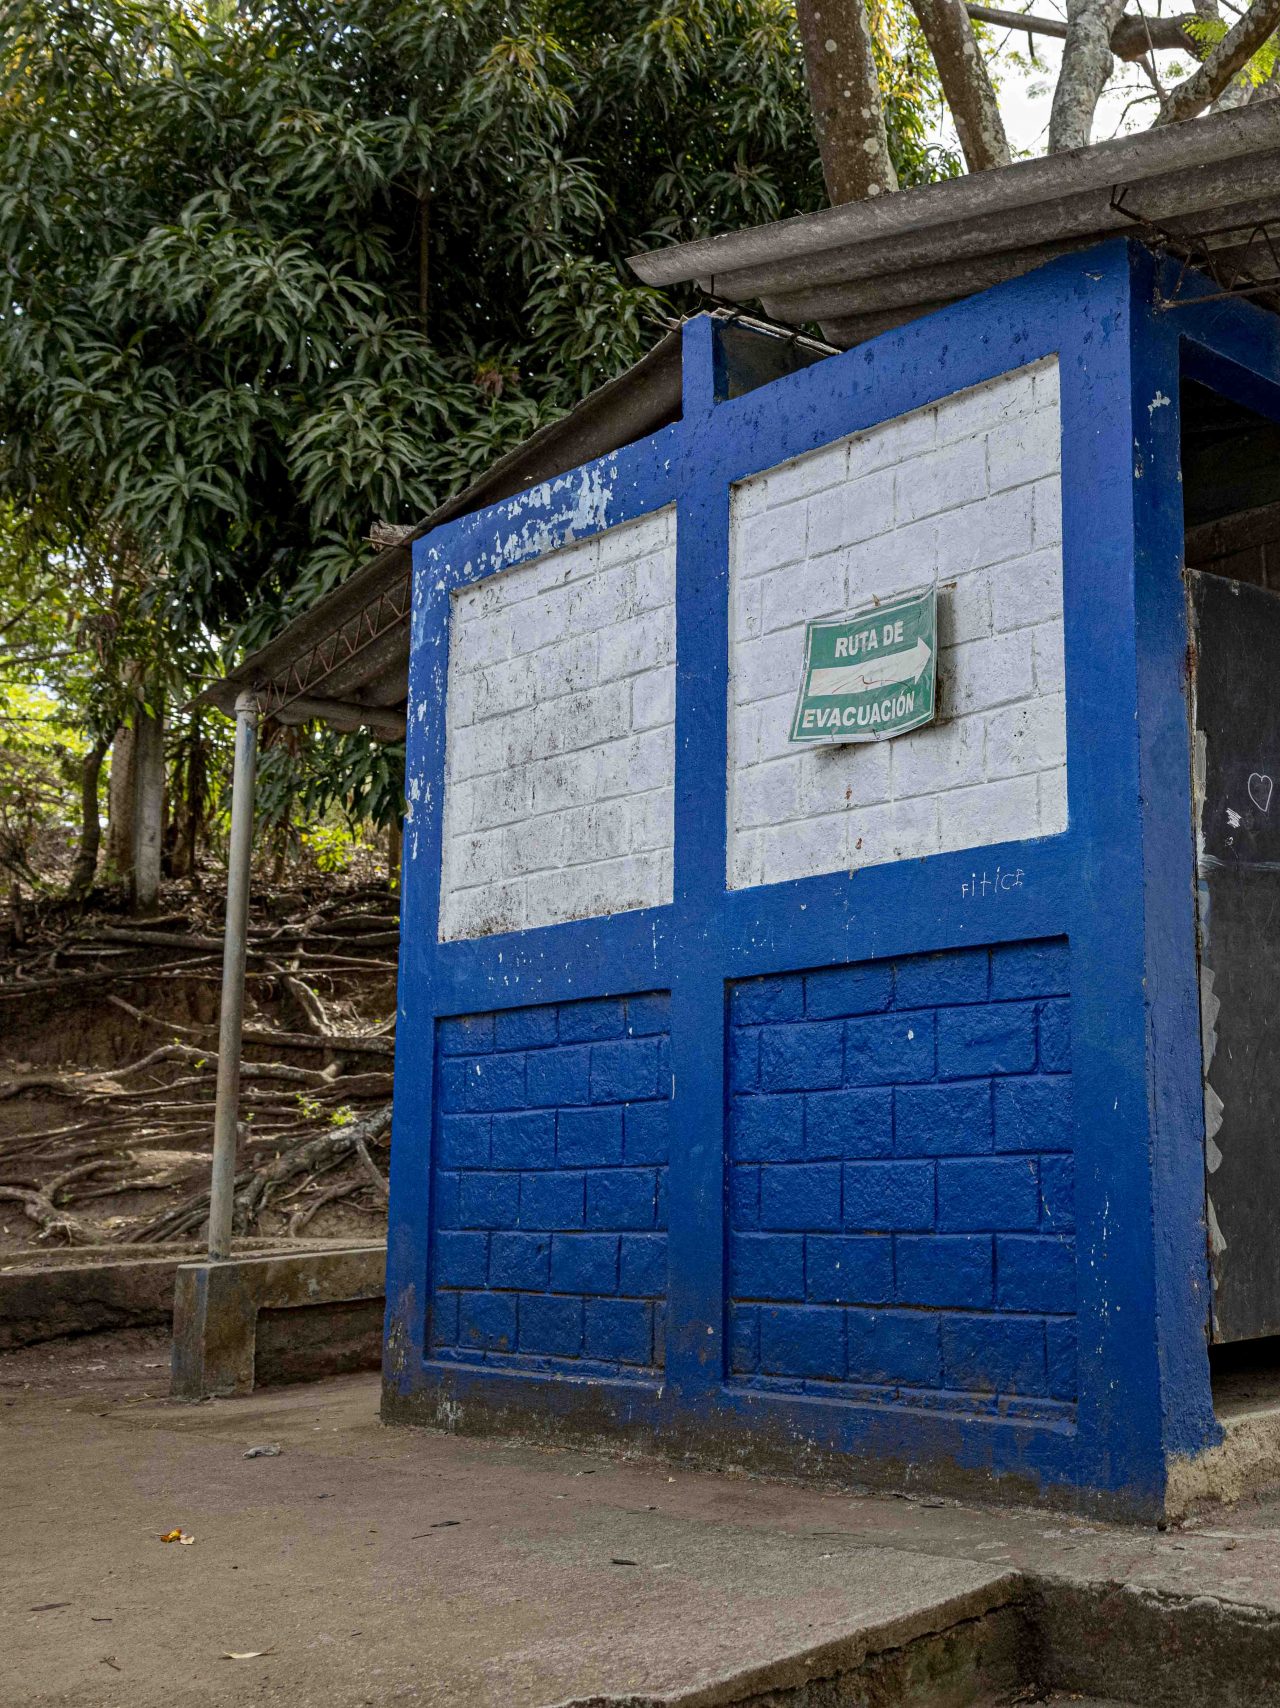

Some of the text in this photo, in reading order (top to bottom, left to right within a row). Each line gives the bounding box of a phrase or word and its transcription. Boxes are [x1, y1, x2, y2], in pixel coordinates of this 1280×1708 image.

[834, 620, 904, 658] RUTA DE
[801, 690, 916, 729] EVACUACIÓN
